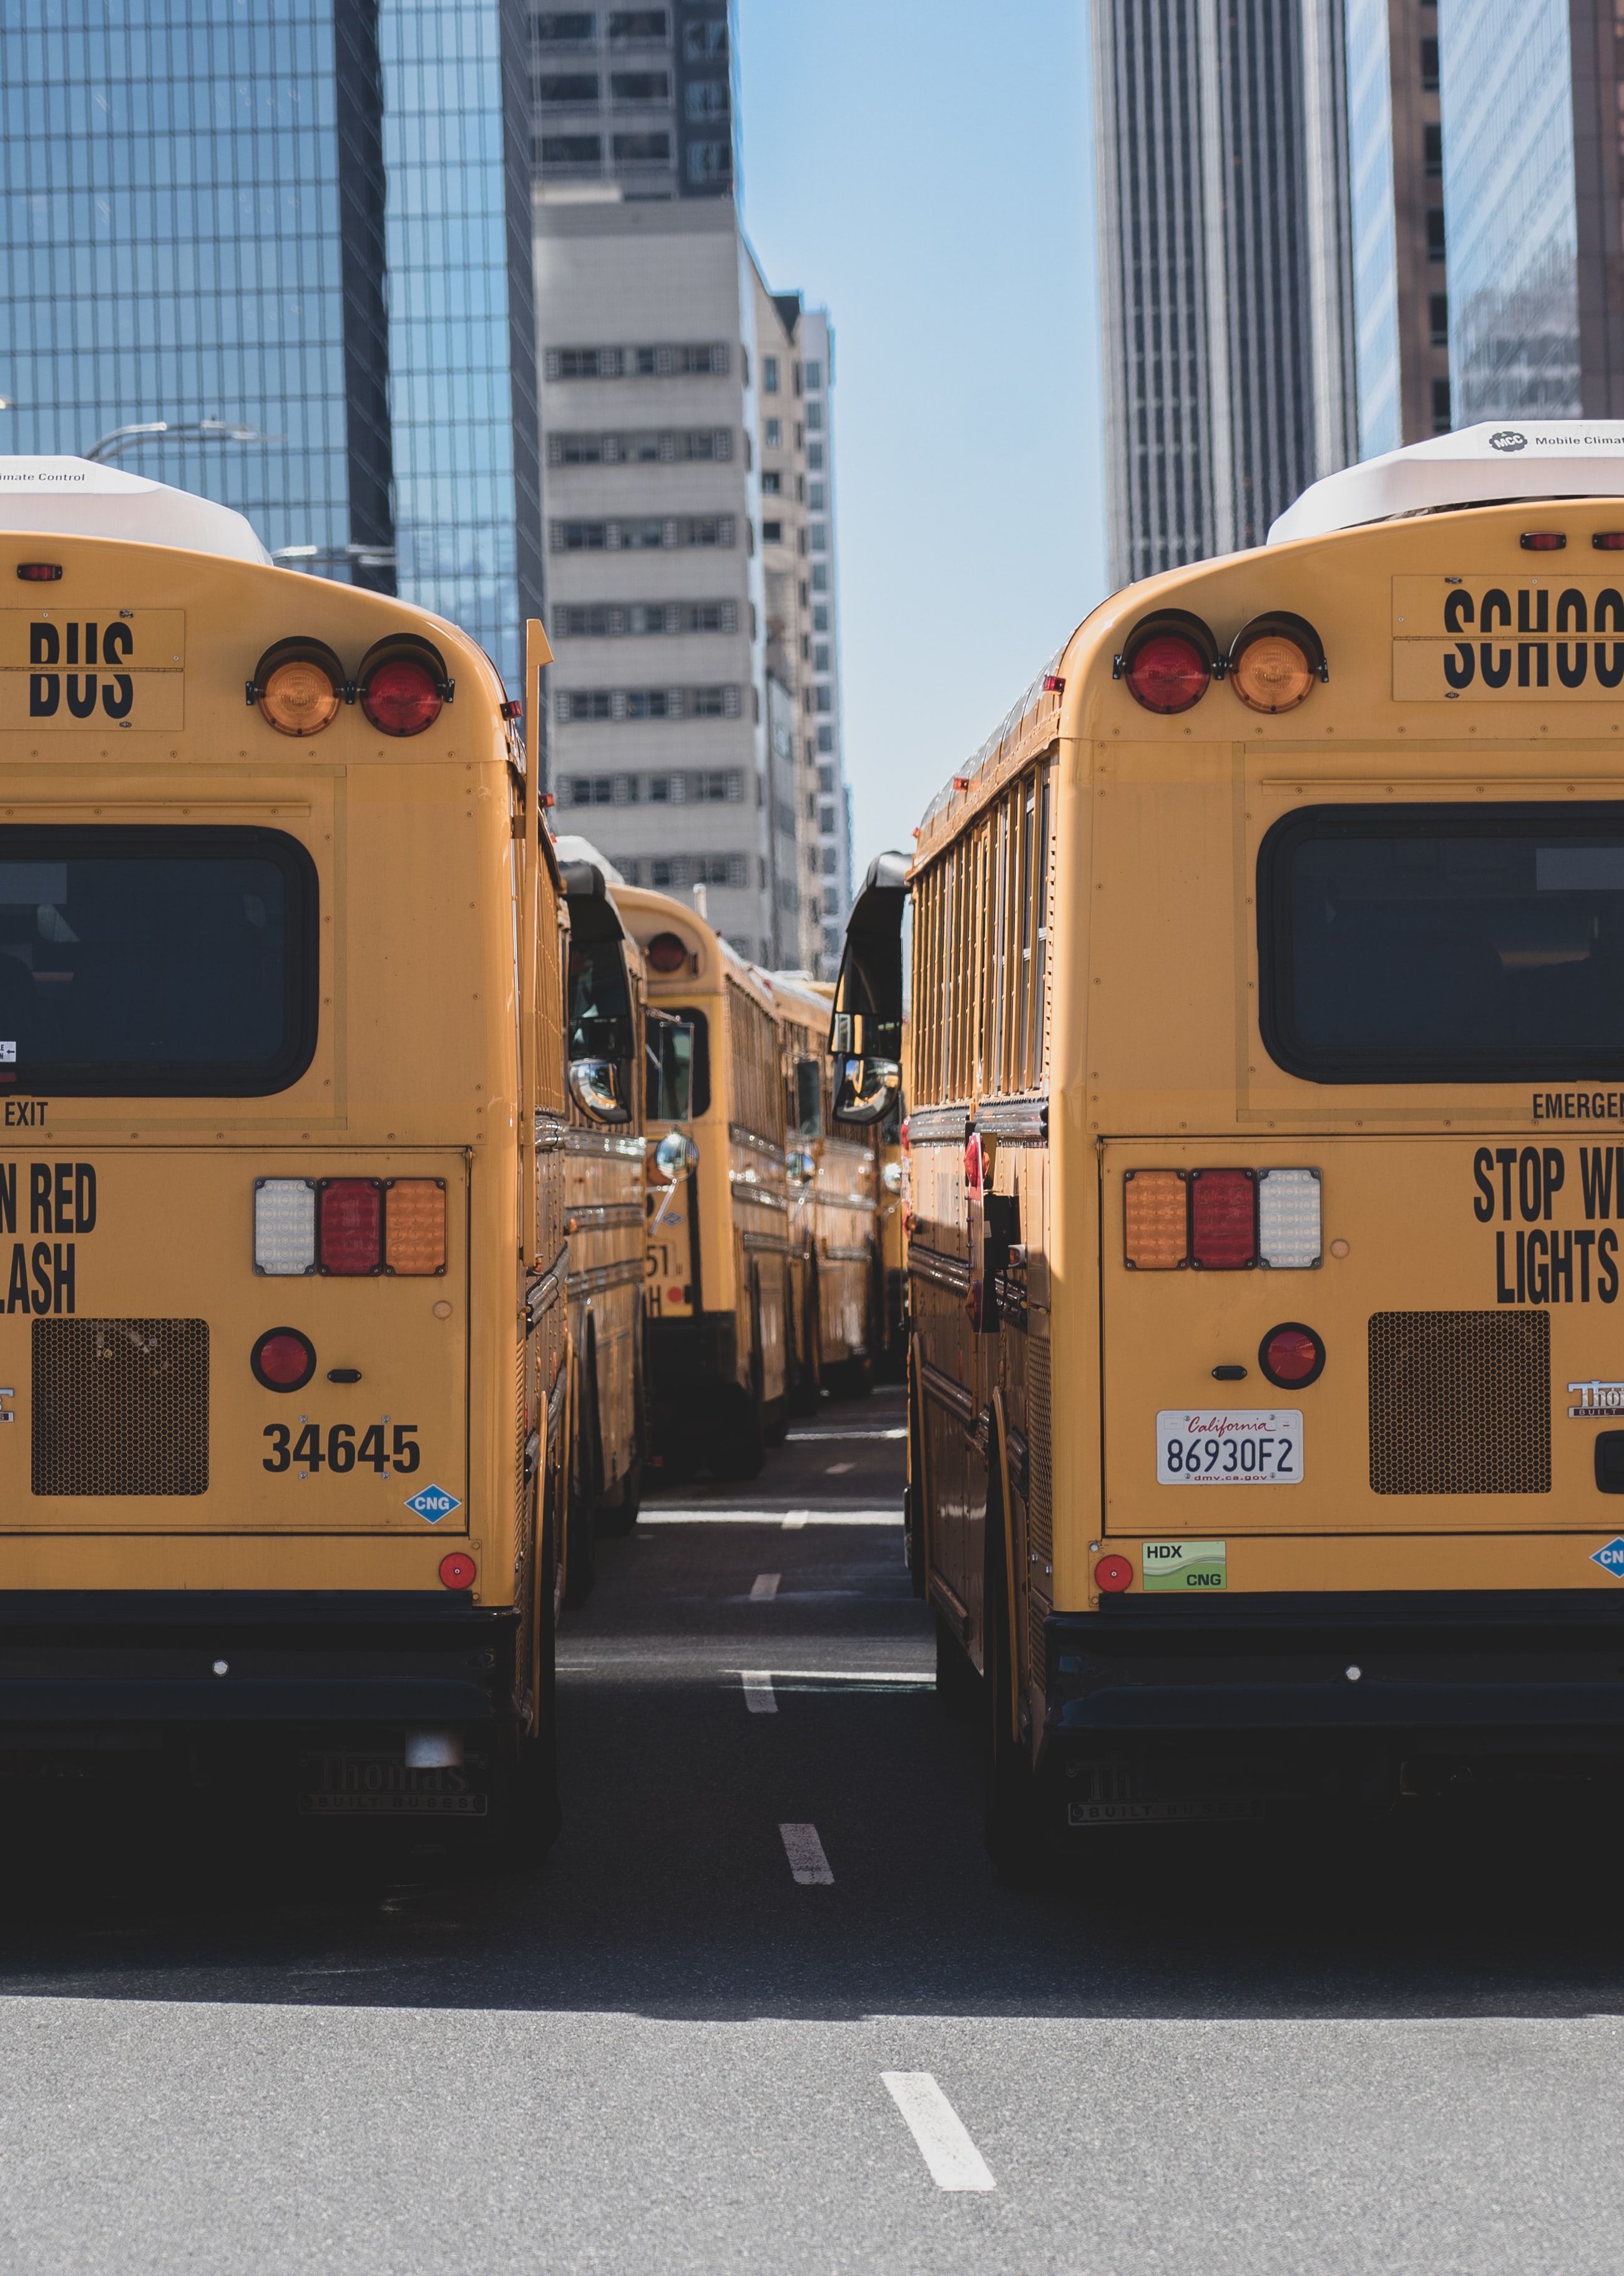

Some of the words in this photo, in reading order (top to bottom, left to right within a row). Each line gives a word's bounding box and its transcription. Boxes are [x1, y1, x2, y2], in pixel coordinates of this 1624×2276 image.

[1494, 434, 1523, 448] MCC
[1443, 588, 1624, 689] SCHOO
[30, 622, 133, 719] BUS
[5, 1102, 48, 1126] EXIT
[1474, 1146, 1565, 1223] STOP
[31, 1163, 96, 1233] RED
[0, 1242, 75, 1315] ASH
[1496, 1228, 1619, 1305] LIGHTS
[1568, 1381, 1624, 1407] Tho
[1188, 1416, 1276, 1438] California
[263, 1423, 420, 1473] 34645
[1168, 1438, 1293, 1473] 86930F2
[414, 1497, 449, 1510] CNG
[1147, 1545, 1183, 1559] HDX
[1186, 1574, 1221, 1586] CNG
[318, 1797, 379, 1808] BUILT
[393, 1798, 469, 1808] BUSES
[1090, 1803, 1152, 1818] BUILT
